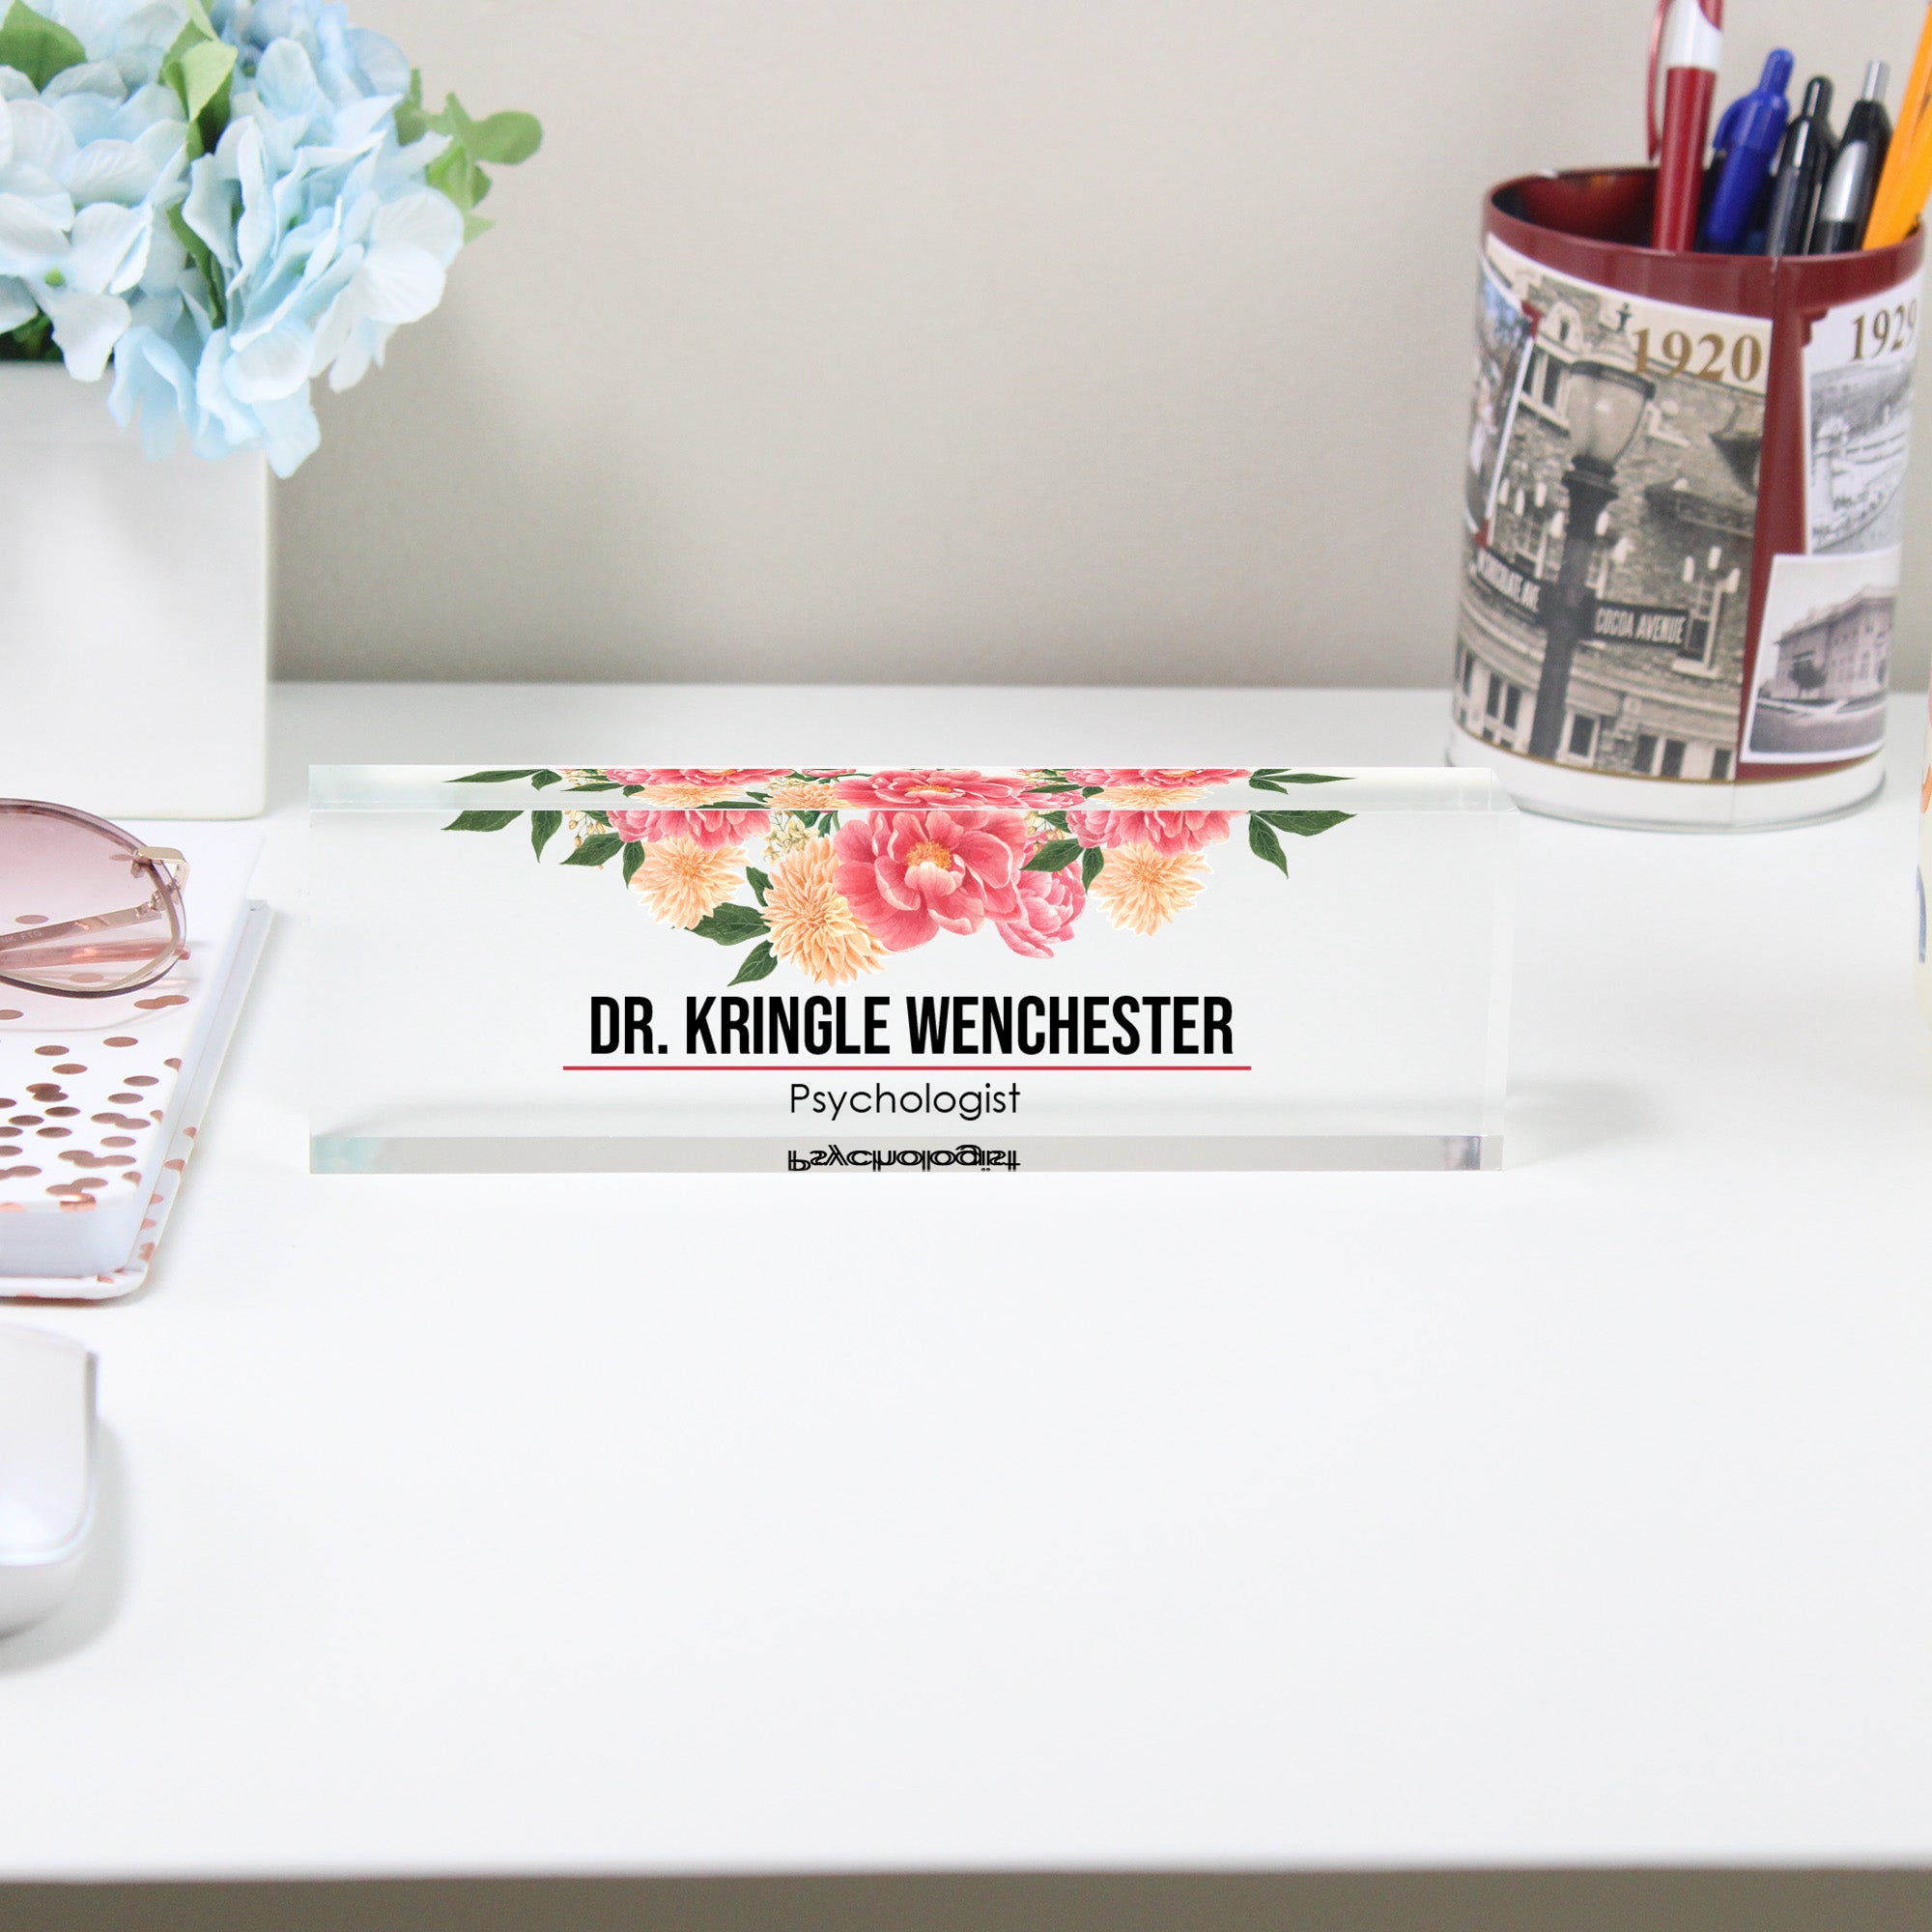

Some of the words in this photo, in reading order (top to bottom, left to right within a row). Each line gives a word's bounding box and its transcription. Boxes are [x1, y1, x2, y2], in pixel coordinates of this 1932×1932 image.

[1631, 327, 1763, 383] 1920
[1595, 607, 1634, 639] COCOA
[1635, 613, 1686, 644] AVENUE
[591, 997, 668, 1054] DR.
[687, 996, 890, 1055] KRINGLE
[906, 996, 1233, 1055] WENCHESTER
[792, 1083, 1020, 1121] Psychologist
